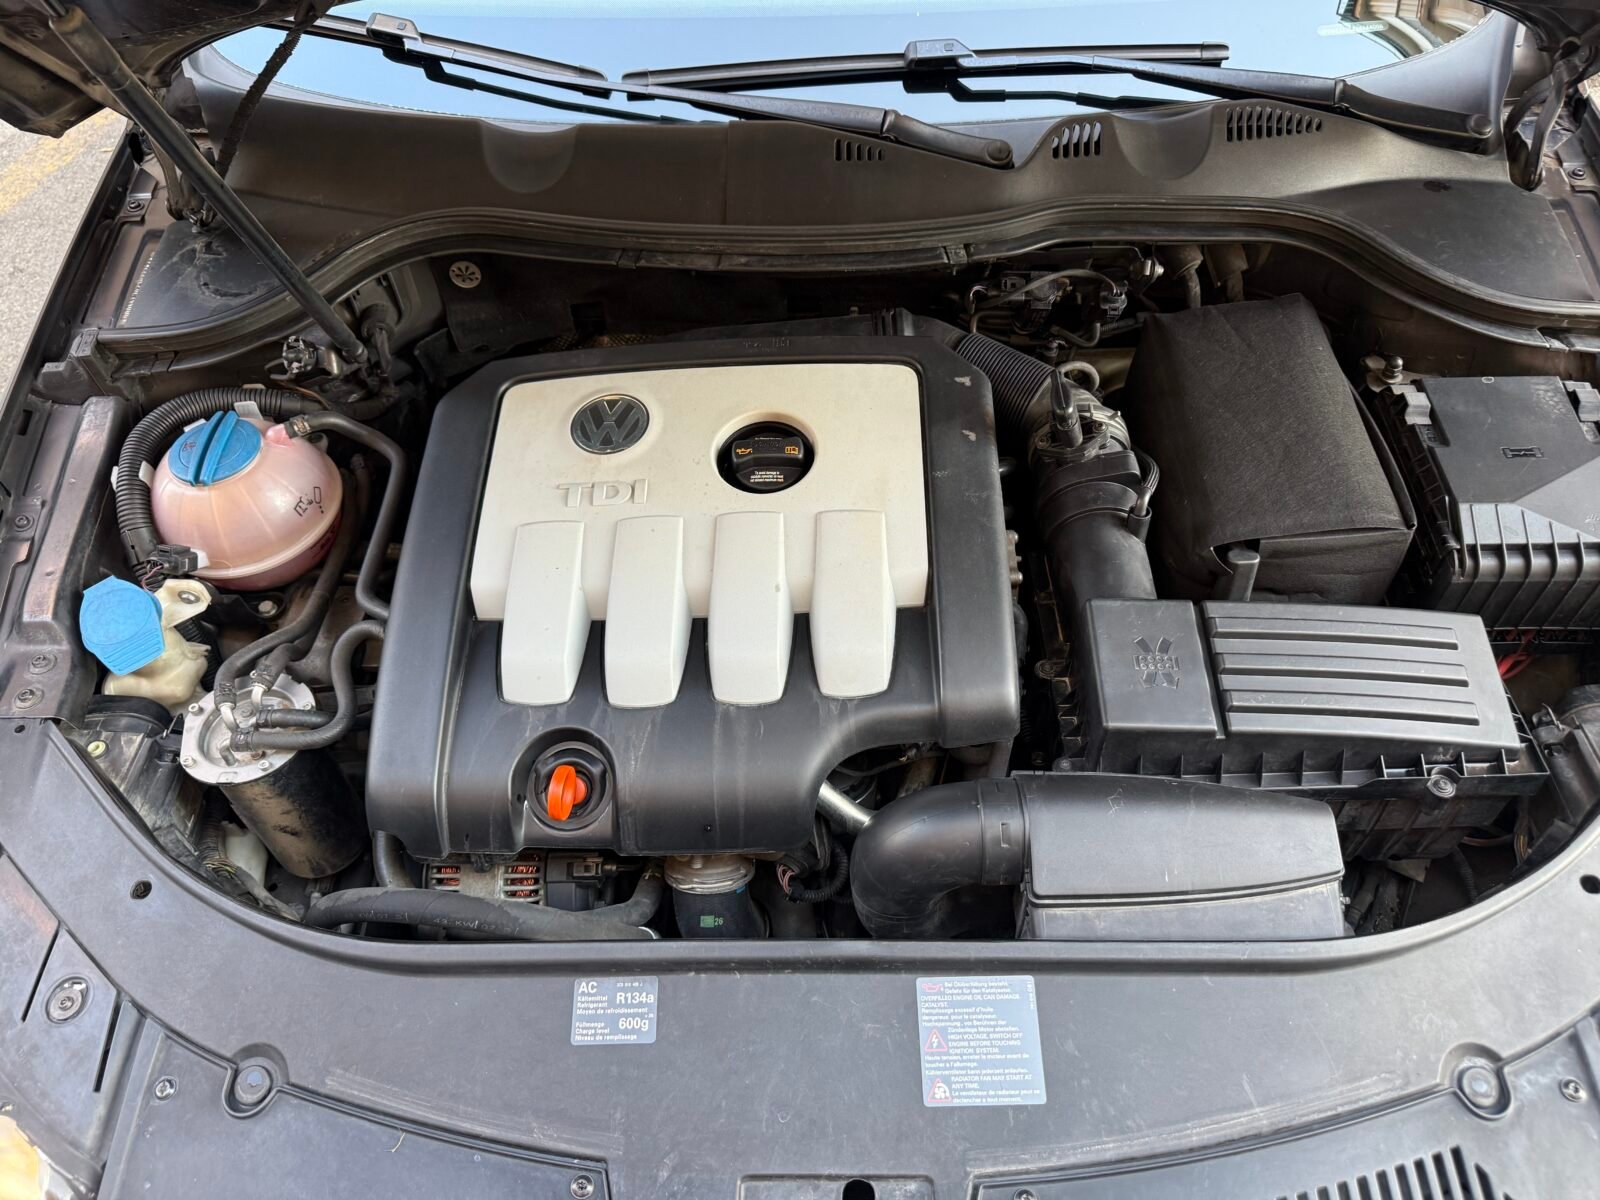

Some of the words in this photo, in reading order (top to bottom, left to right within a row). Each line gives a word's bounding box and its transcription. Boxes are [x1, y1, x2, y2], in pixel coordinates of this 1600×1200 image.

[557, 478, 648, 508] TDI
[714, 917, 724, 926] 26
[578, 981, 598, 994] AC
[616, 992, 654, 1004] R134a
[618, 1017, 649, 1032] 600g
